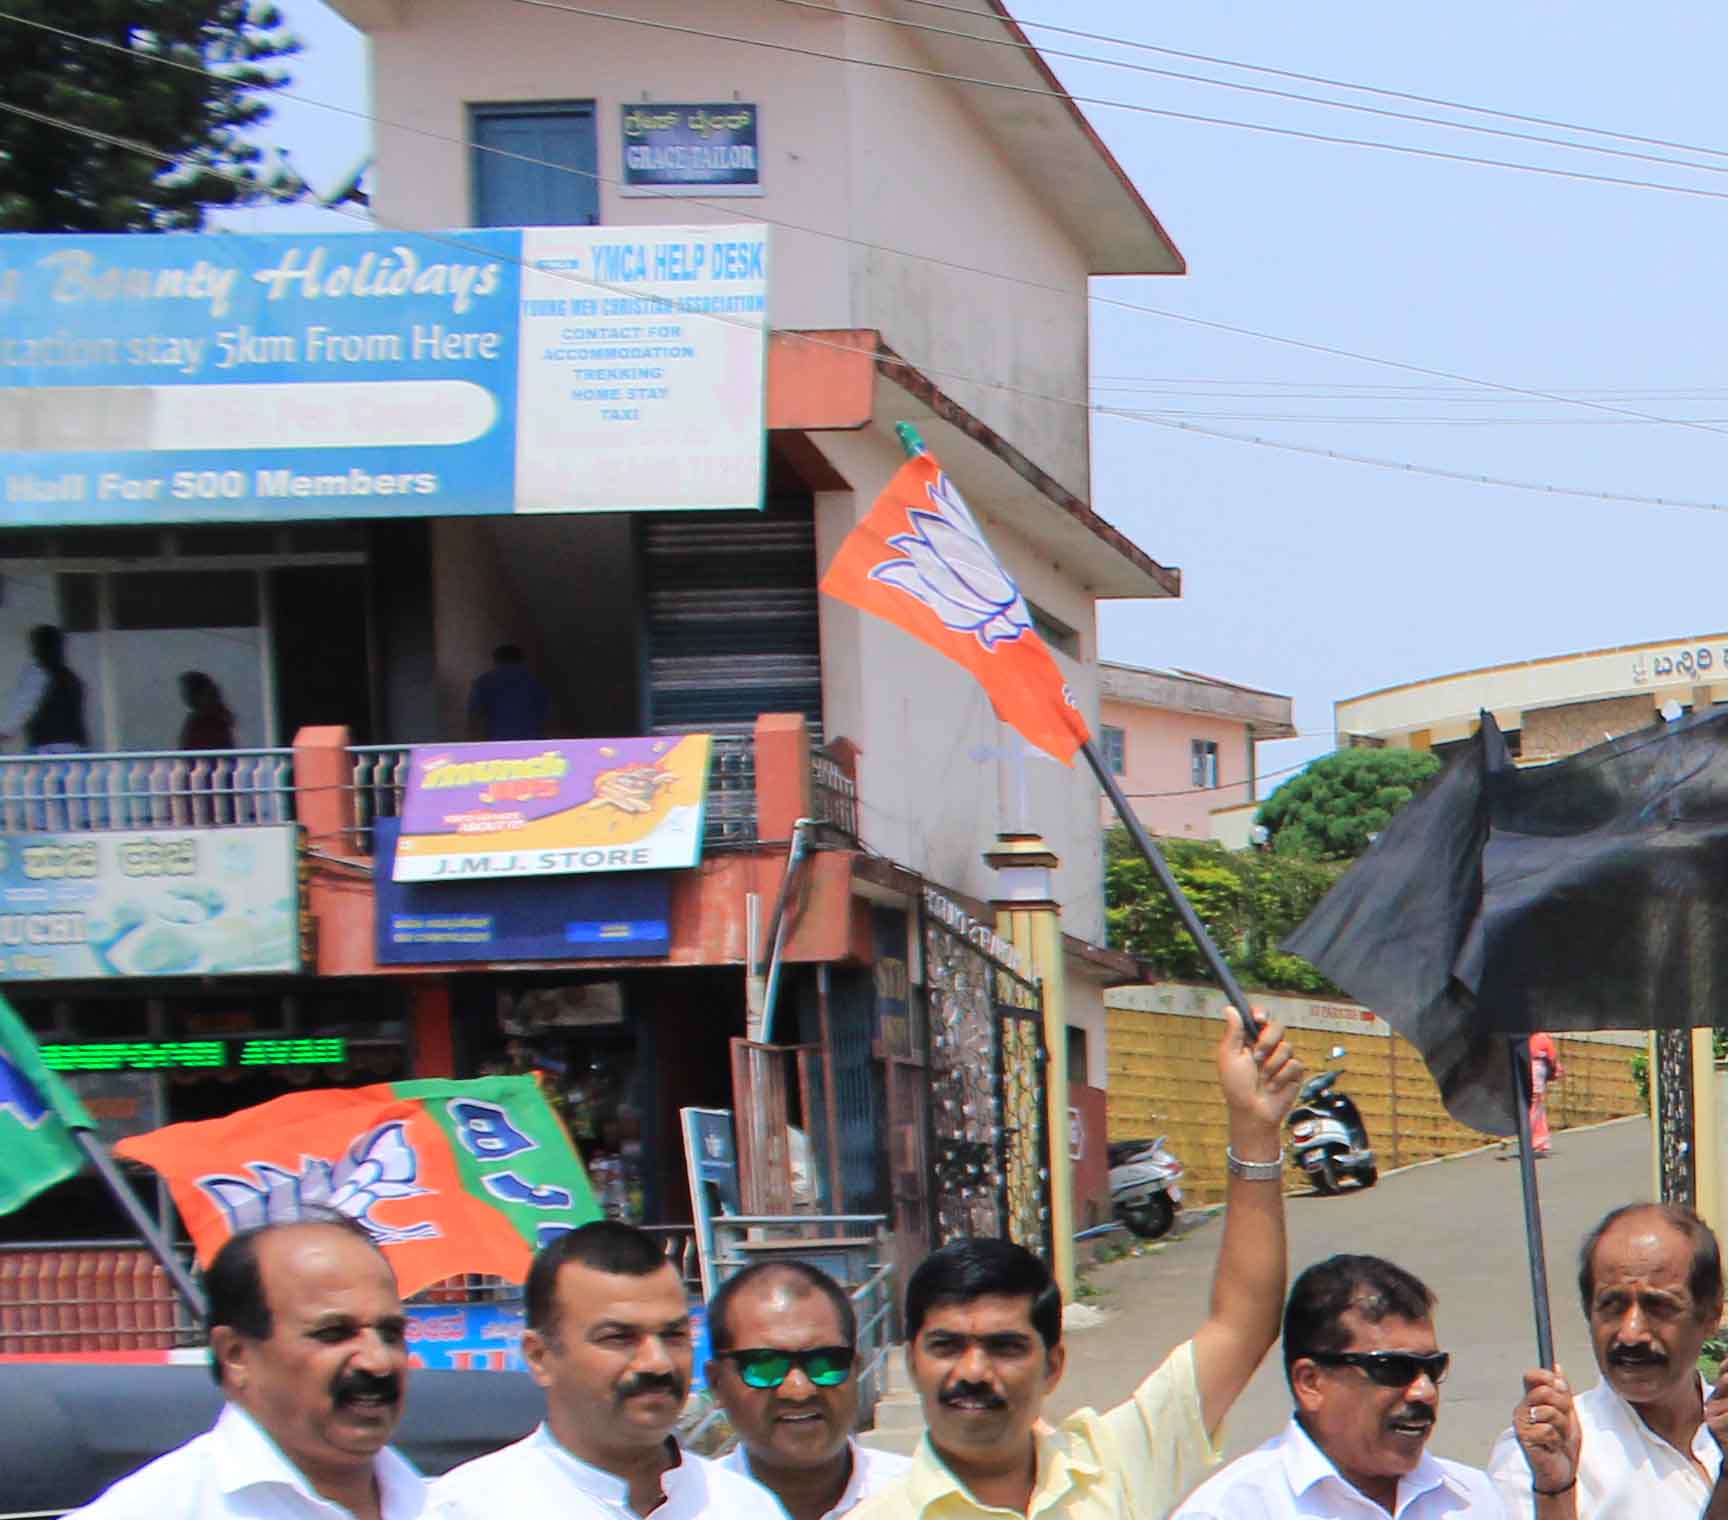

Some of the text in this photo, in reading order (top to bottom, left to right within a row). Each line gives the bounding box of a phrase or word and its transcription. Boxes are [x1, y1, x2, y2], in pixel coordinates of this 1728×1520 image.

[592, 241, 765, 283] YMCA HELP DESK
[252, 245, 501, 315] Holidays
[560, 325, 682, 341] CONTACT FOR
[127, 334, 204, 375] stay
[215, 324, 297, 369] 5km
[305, 325, 404, 363] From
[412, 324, 501, 361] Here
[542, 346, 696, 361] ACCOMMODATION
[573, 367, 665, 382] TREKKING
[571, 386, 669, 401] HOME STAY
[600, 408, 640, 422] TAXI
[97, 472, 163, 500] For
[171, 469, 248, 499] 500
[255, 467, 438, 497] Members
[535, 847, 651, 870] STORE
[0, 910, 87, 946] UCHI
